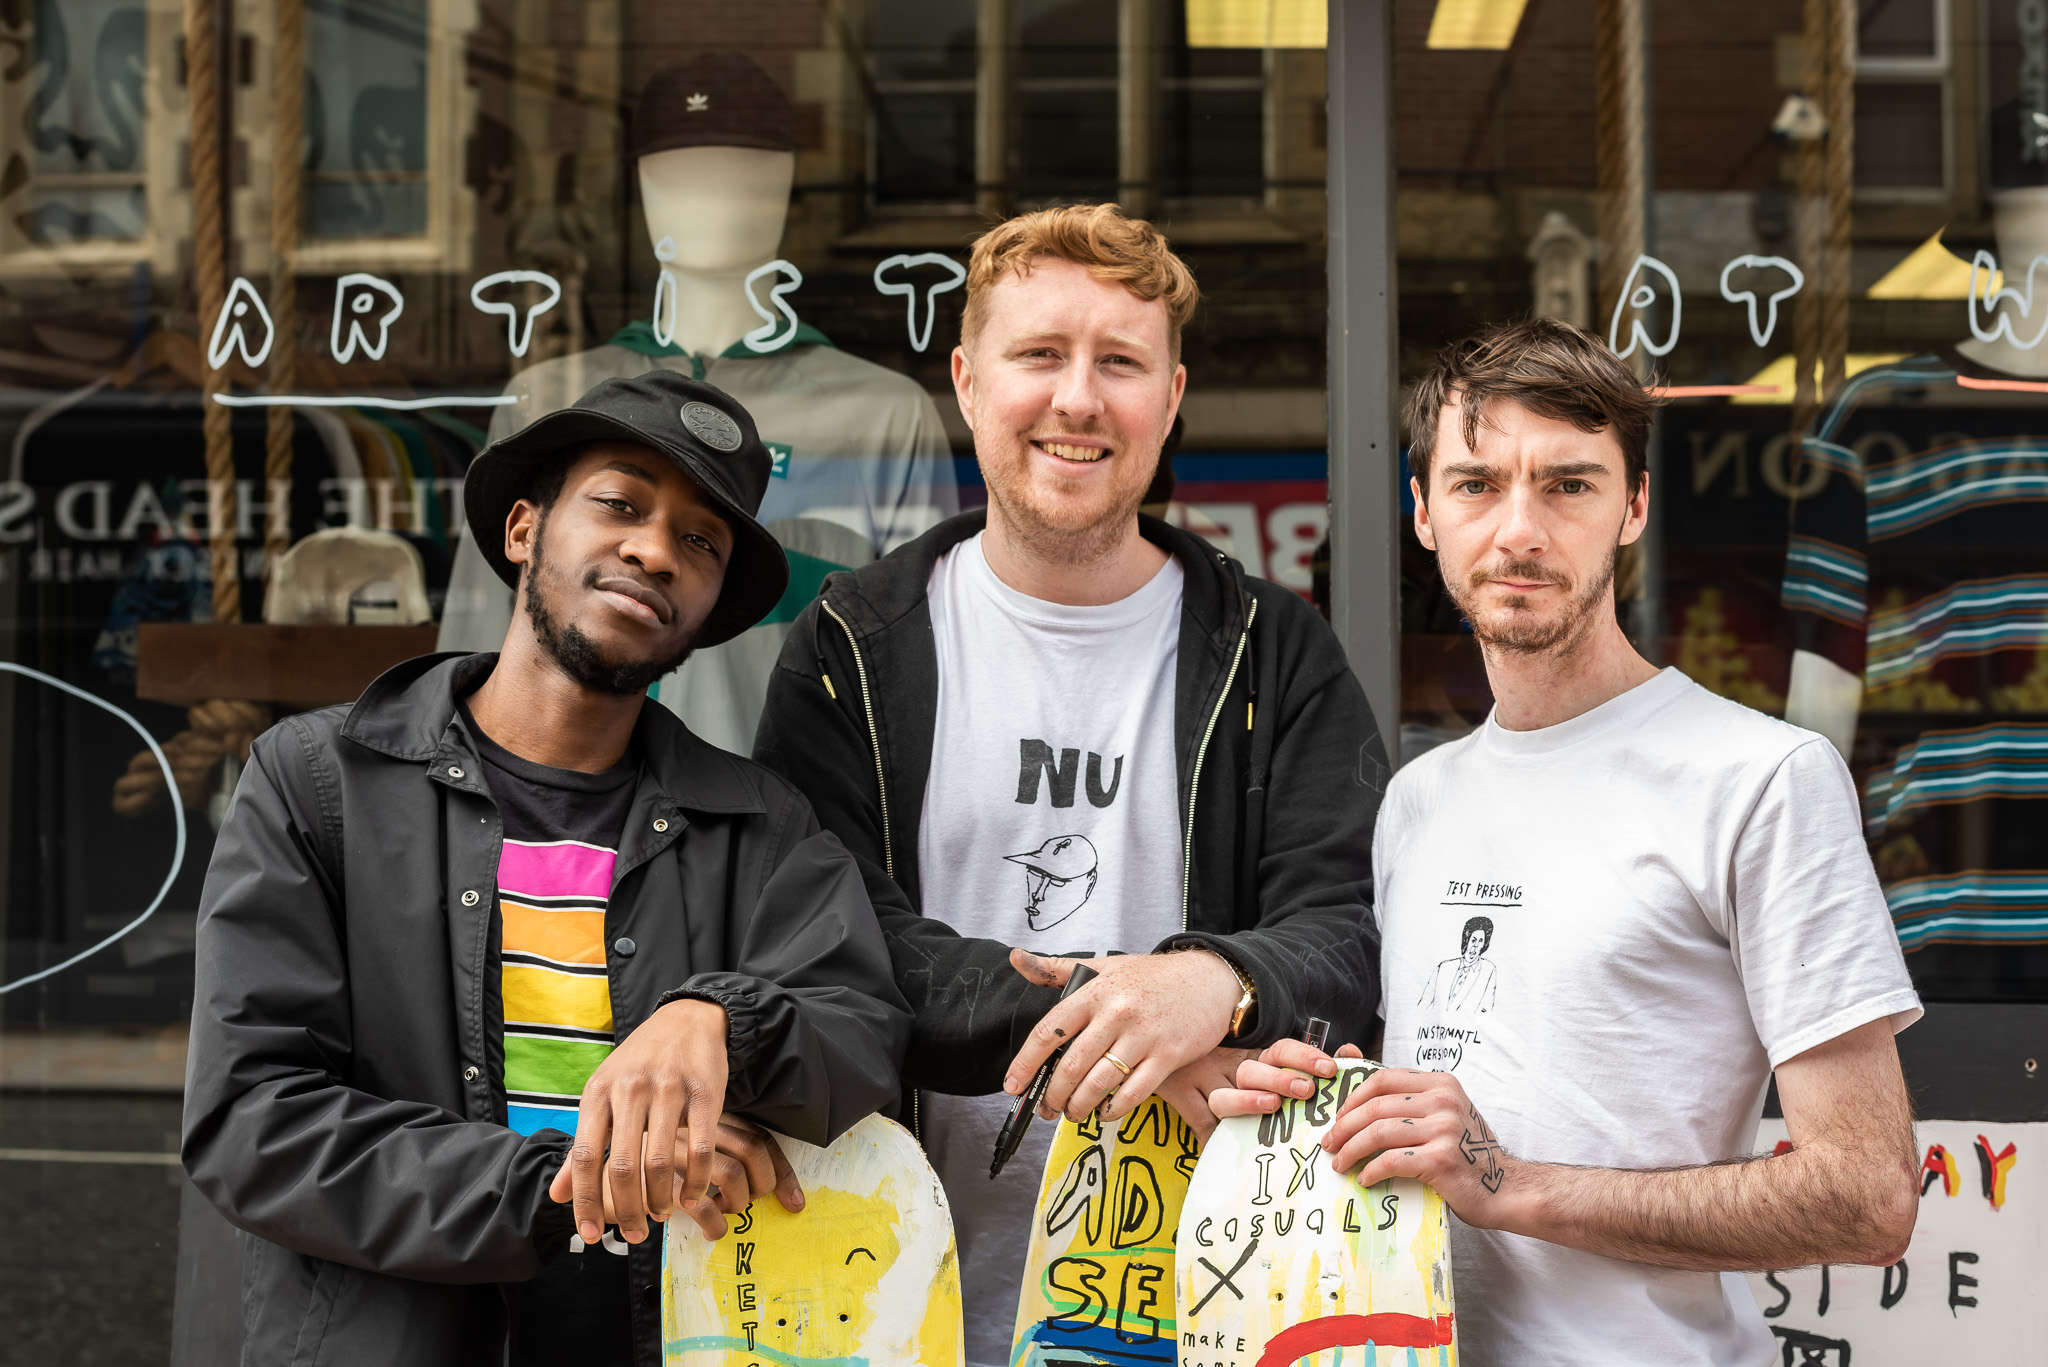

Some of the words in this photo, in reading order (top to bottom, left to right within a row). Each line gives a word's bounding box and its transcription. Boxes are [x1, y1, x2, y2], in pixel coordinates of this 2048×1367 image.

[1015, 738, 1124, 809] NU
[1446, 881, 1472, 897] TEST
[1475, 882, 1523, 900] PRESSING
[734, 1203, 759, 1367] SKET
[1764, 1252, 1980, 1318] SIDE
